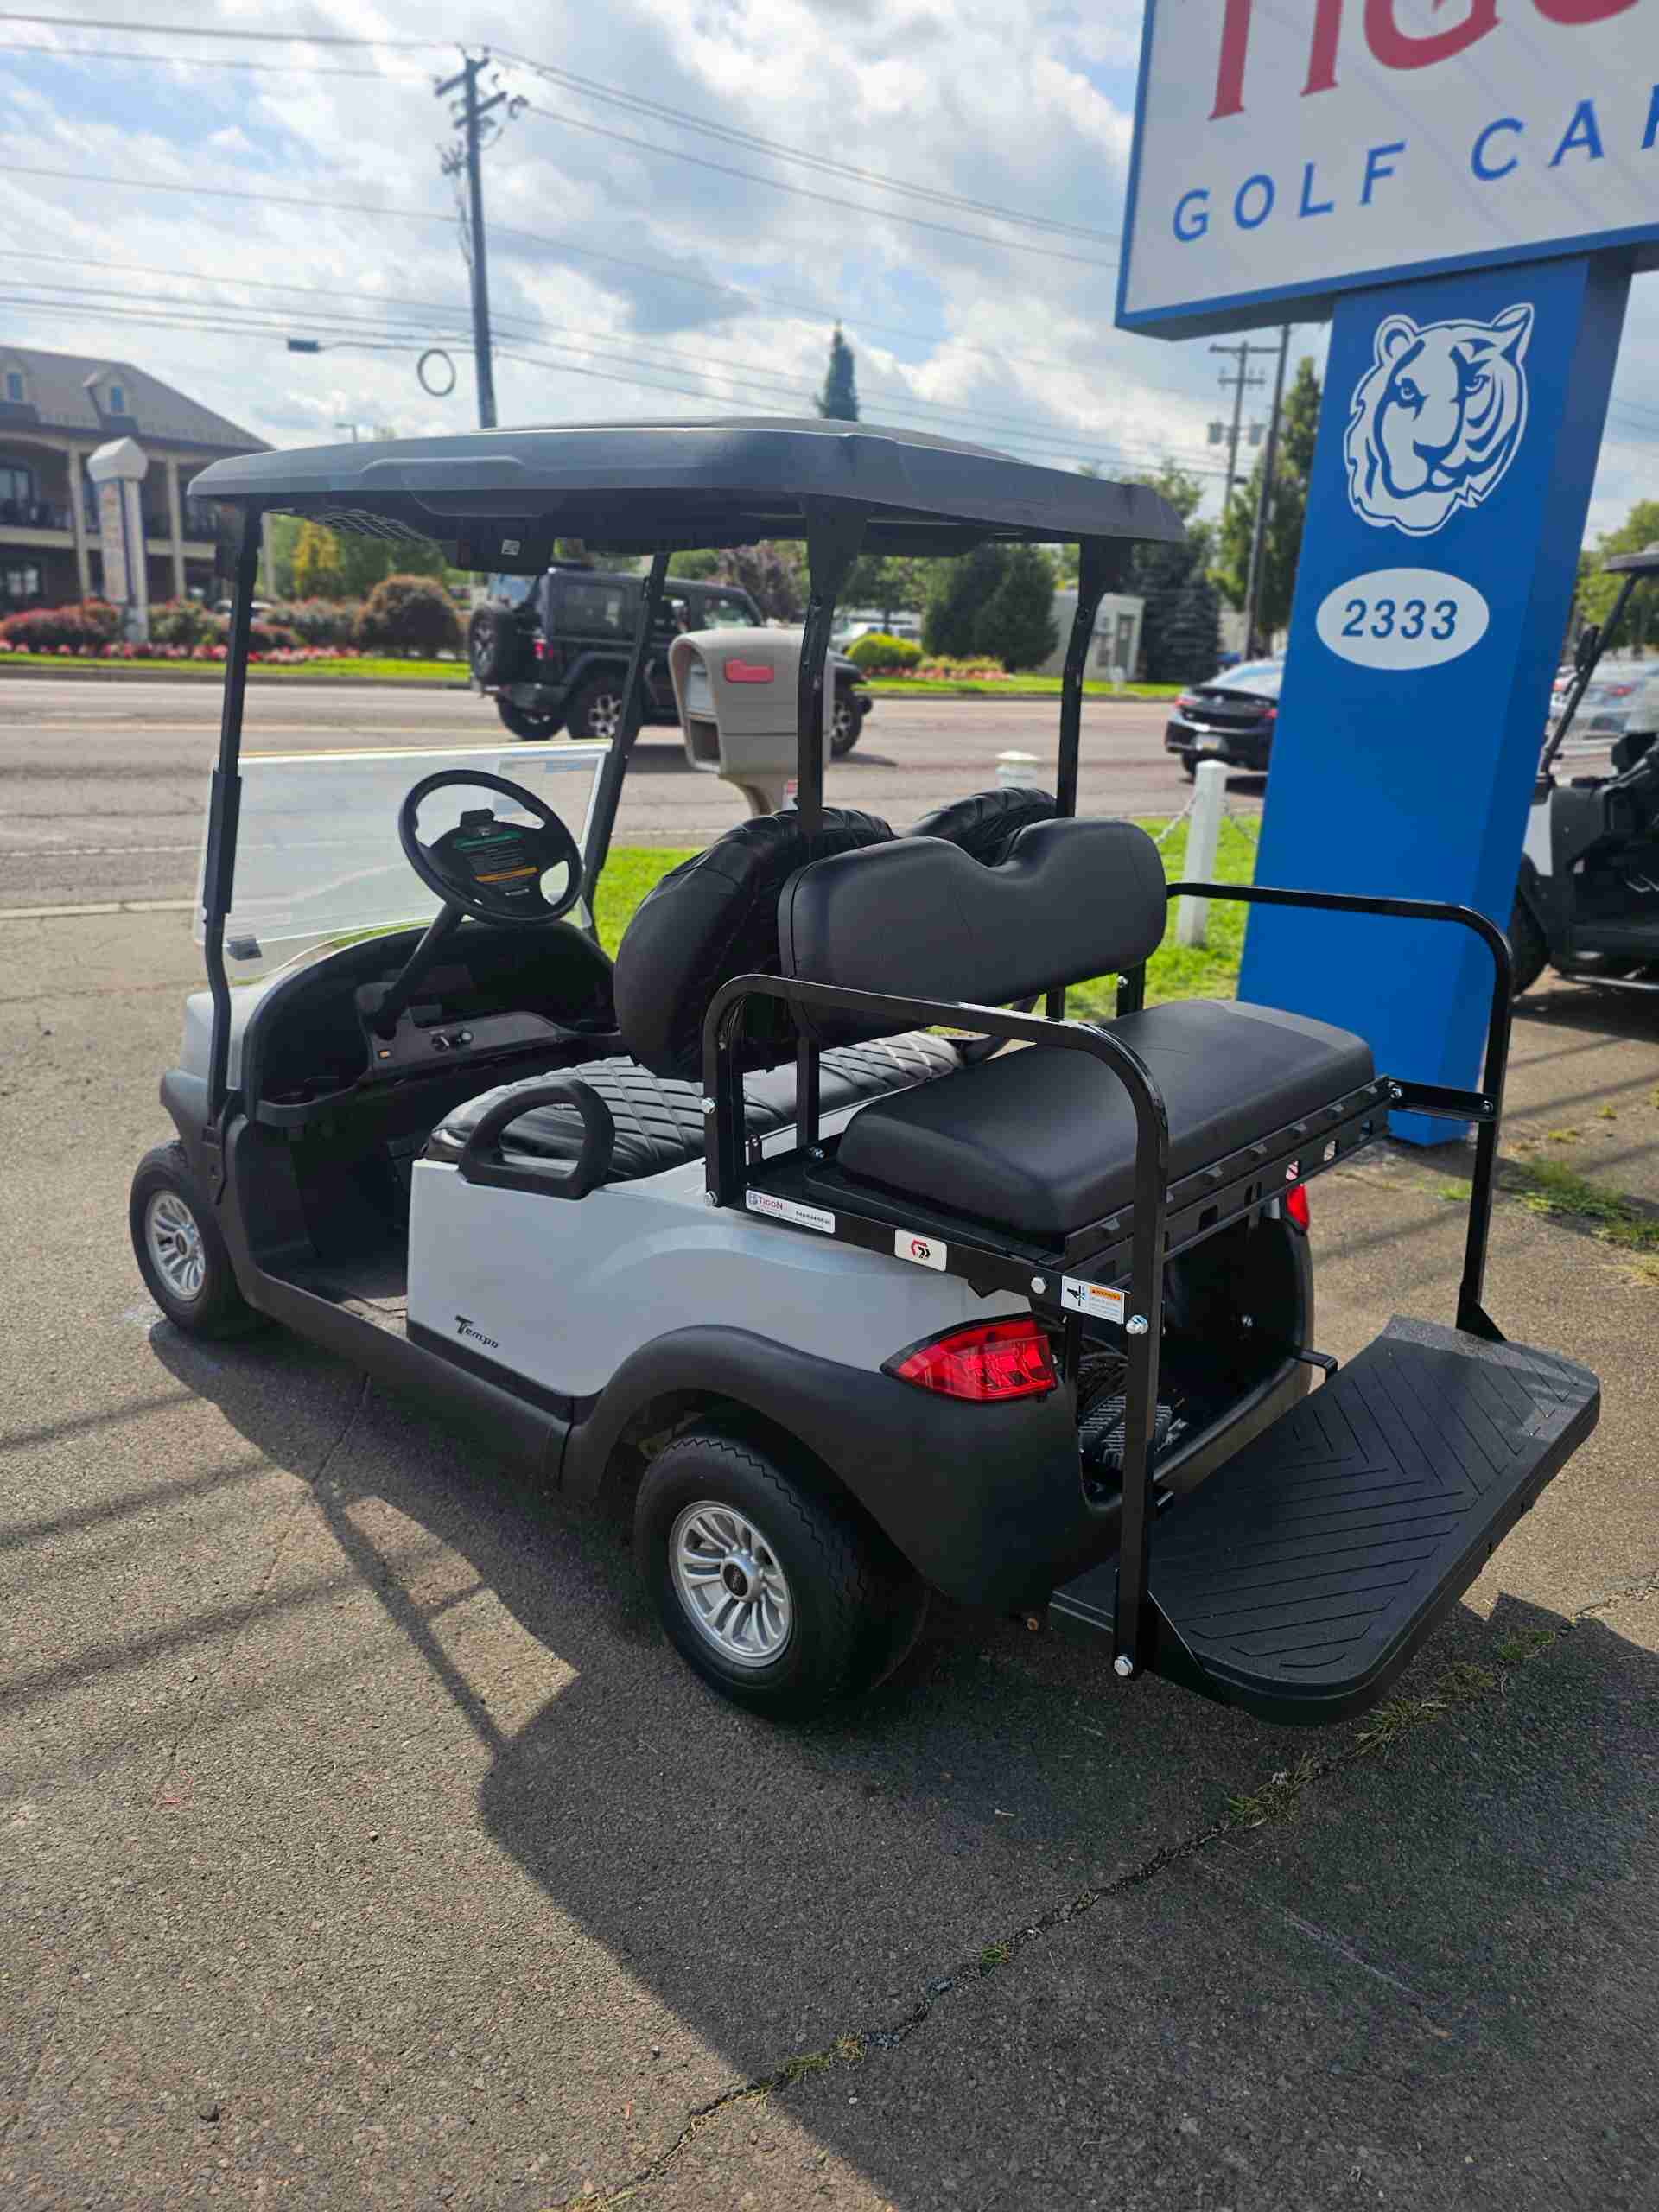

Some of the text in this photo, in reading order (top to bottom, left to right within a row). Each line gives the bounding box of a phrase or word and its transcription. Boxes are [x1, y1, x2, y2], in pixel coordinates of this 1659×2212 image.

[1173, 141, 1407, 243] GOLF
[1341, 599, 1458, 640] 2333
[454, 1315, 499, 1349] Tempo
